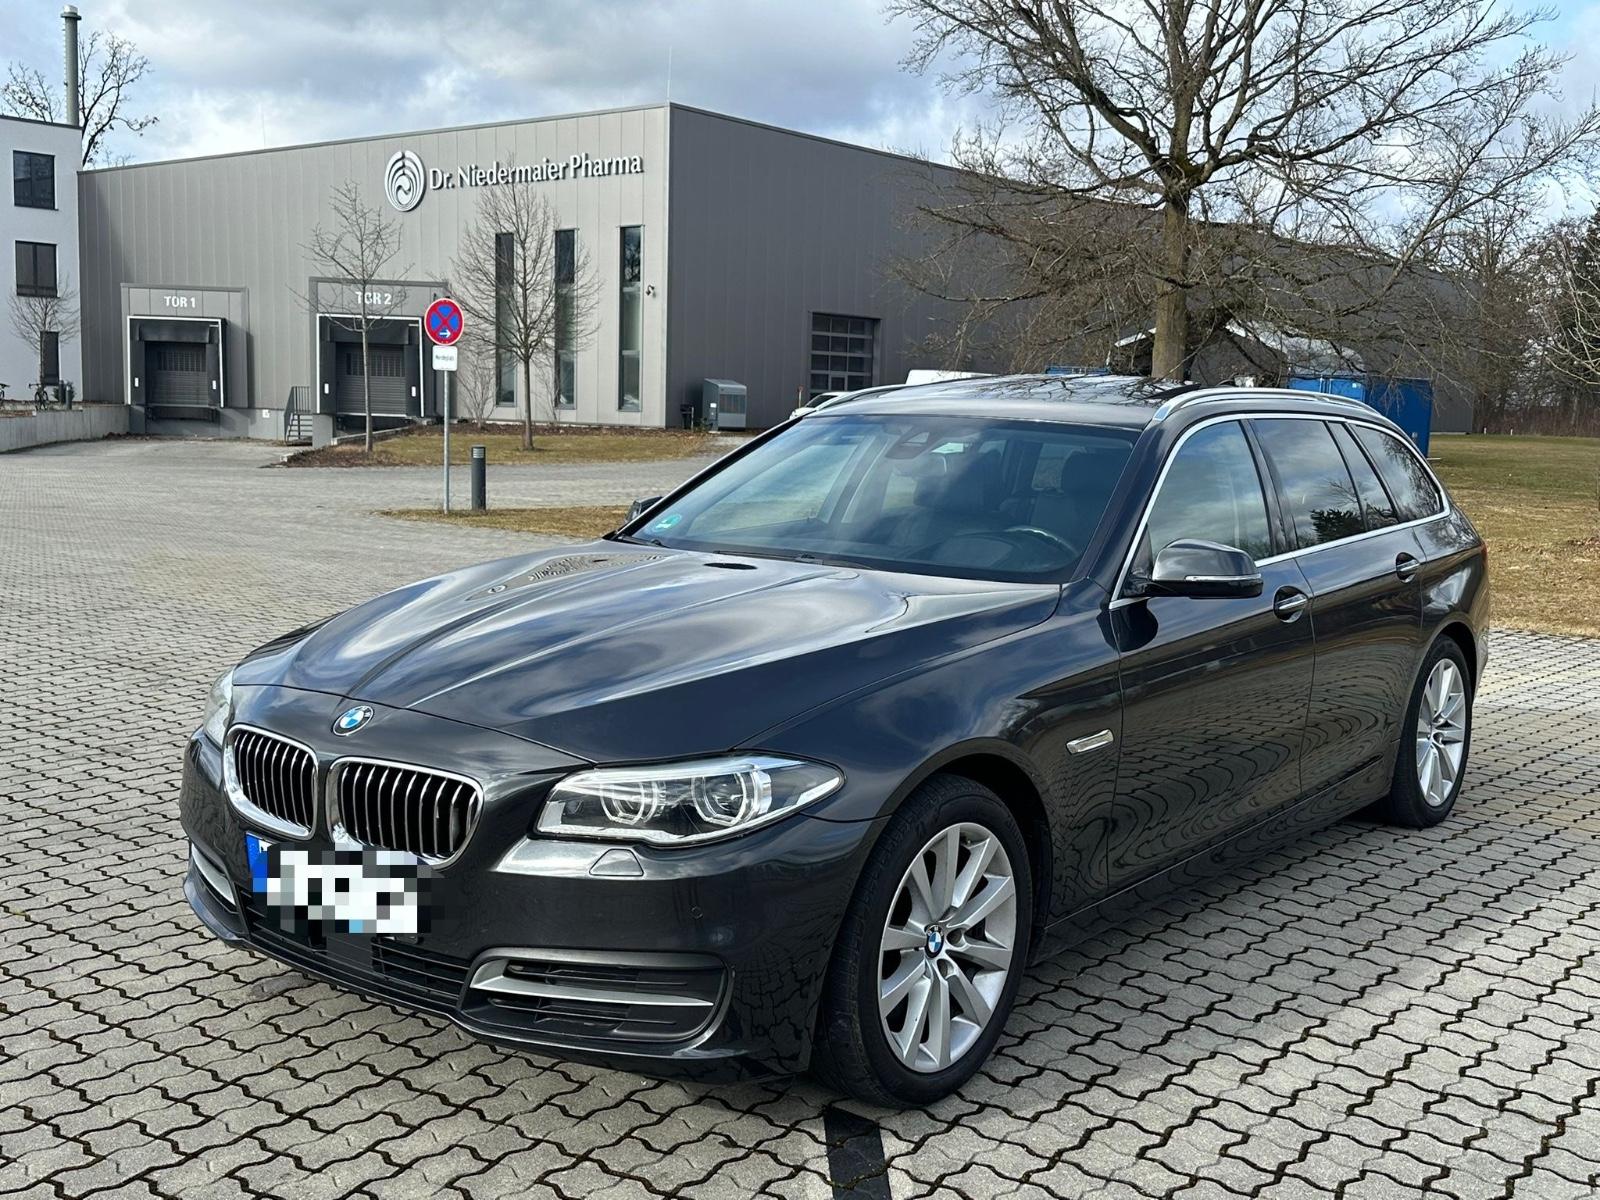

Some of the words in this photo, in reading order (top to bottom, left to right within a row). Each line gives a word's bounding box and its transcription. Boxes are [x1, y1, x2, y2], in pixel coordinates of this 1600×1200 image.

[429, 167, 453, 189] Dr.
[458, 157, 567, 187] Niedermaier
[569, 152, 642, 178] Pharma
[163, 295, 188, 308] TOR
[190, 296, 196, 309] 1
[355, 291, 382, 305] TOR
[384, 292, 392, 305] 2
